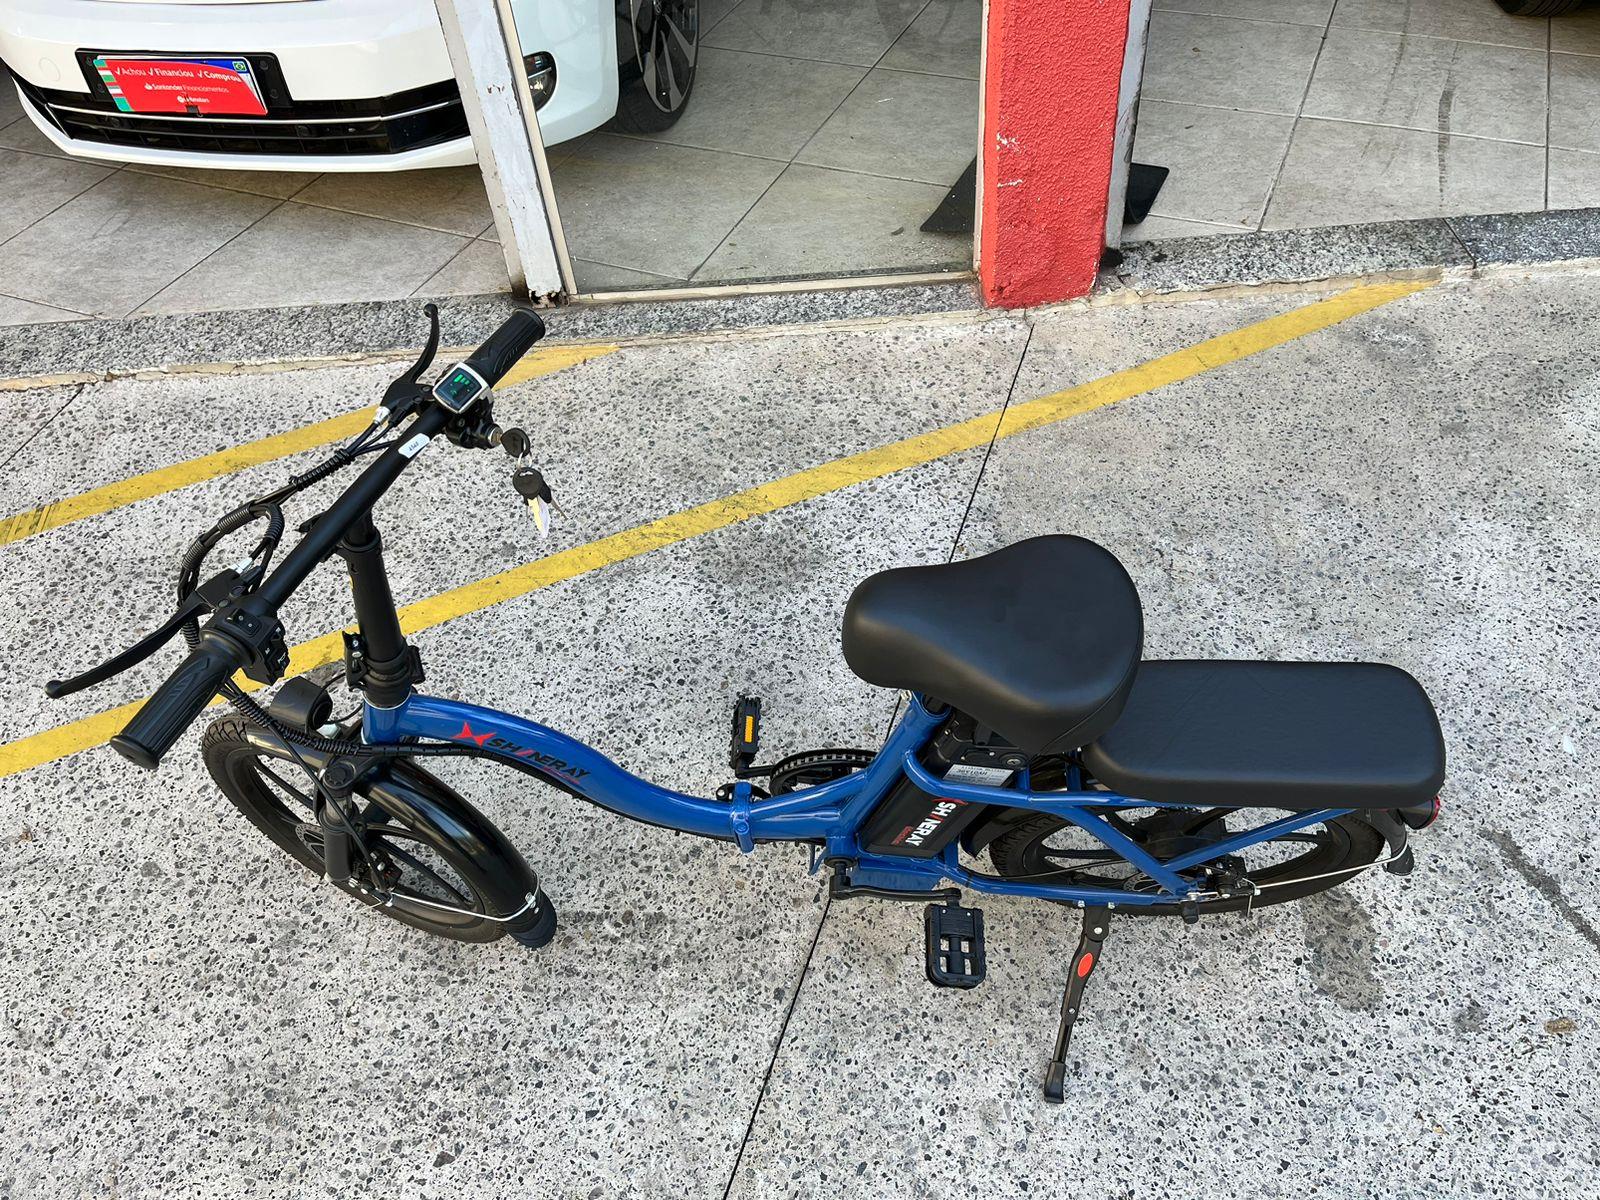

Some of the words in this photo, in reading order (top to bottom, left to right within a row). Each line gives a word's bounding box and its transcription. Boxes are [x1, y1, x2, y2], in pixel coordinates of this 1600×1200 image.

[121, 67, 147, 77] Achou
[155, 68, 195, 78] Financiou
[203, 70, 243, 83] Comprou
[151, 83, 183, 91] Santander
[487, 738, 592, 778] SHINERAY
[905, 801, 957, 847] SHINERAY
